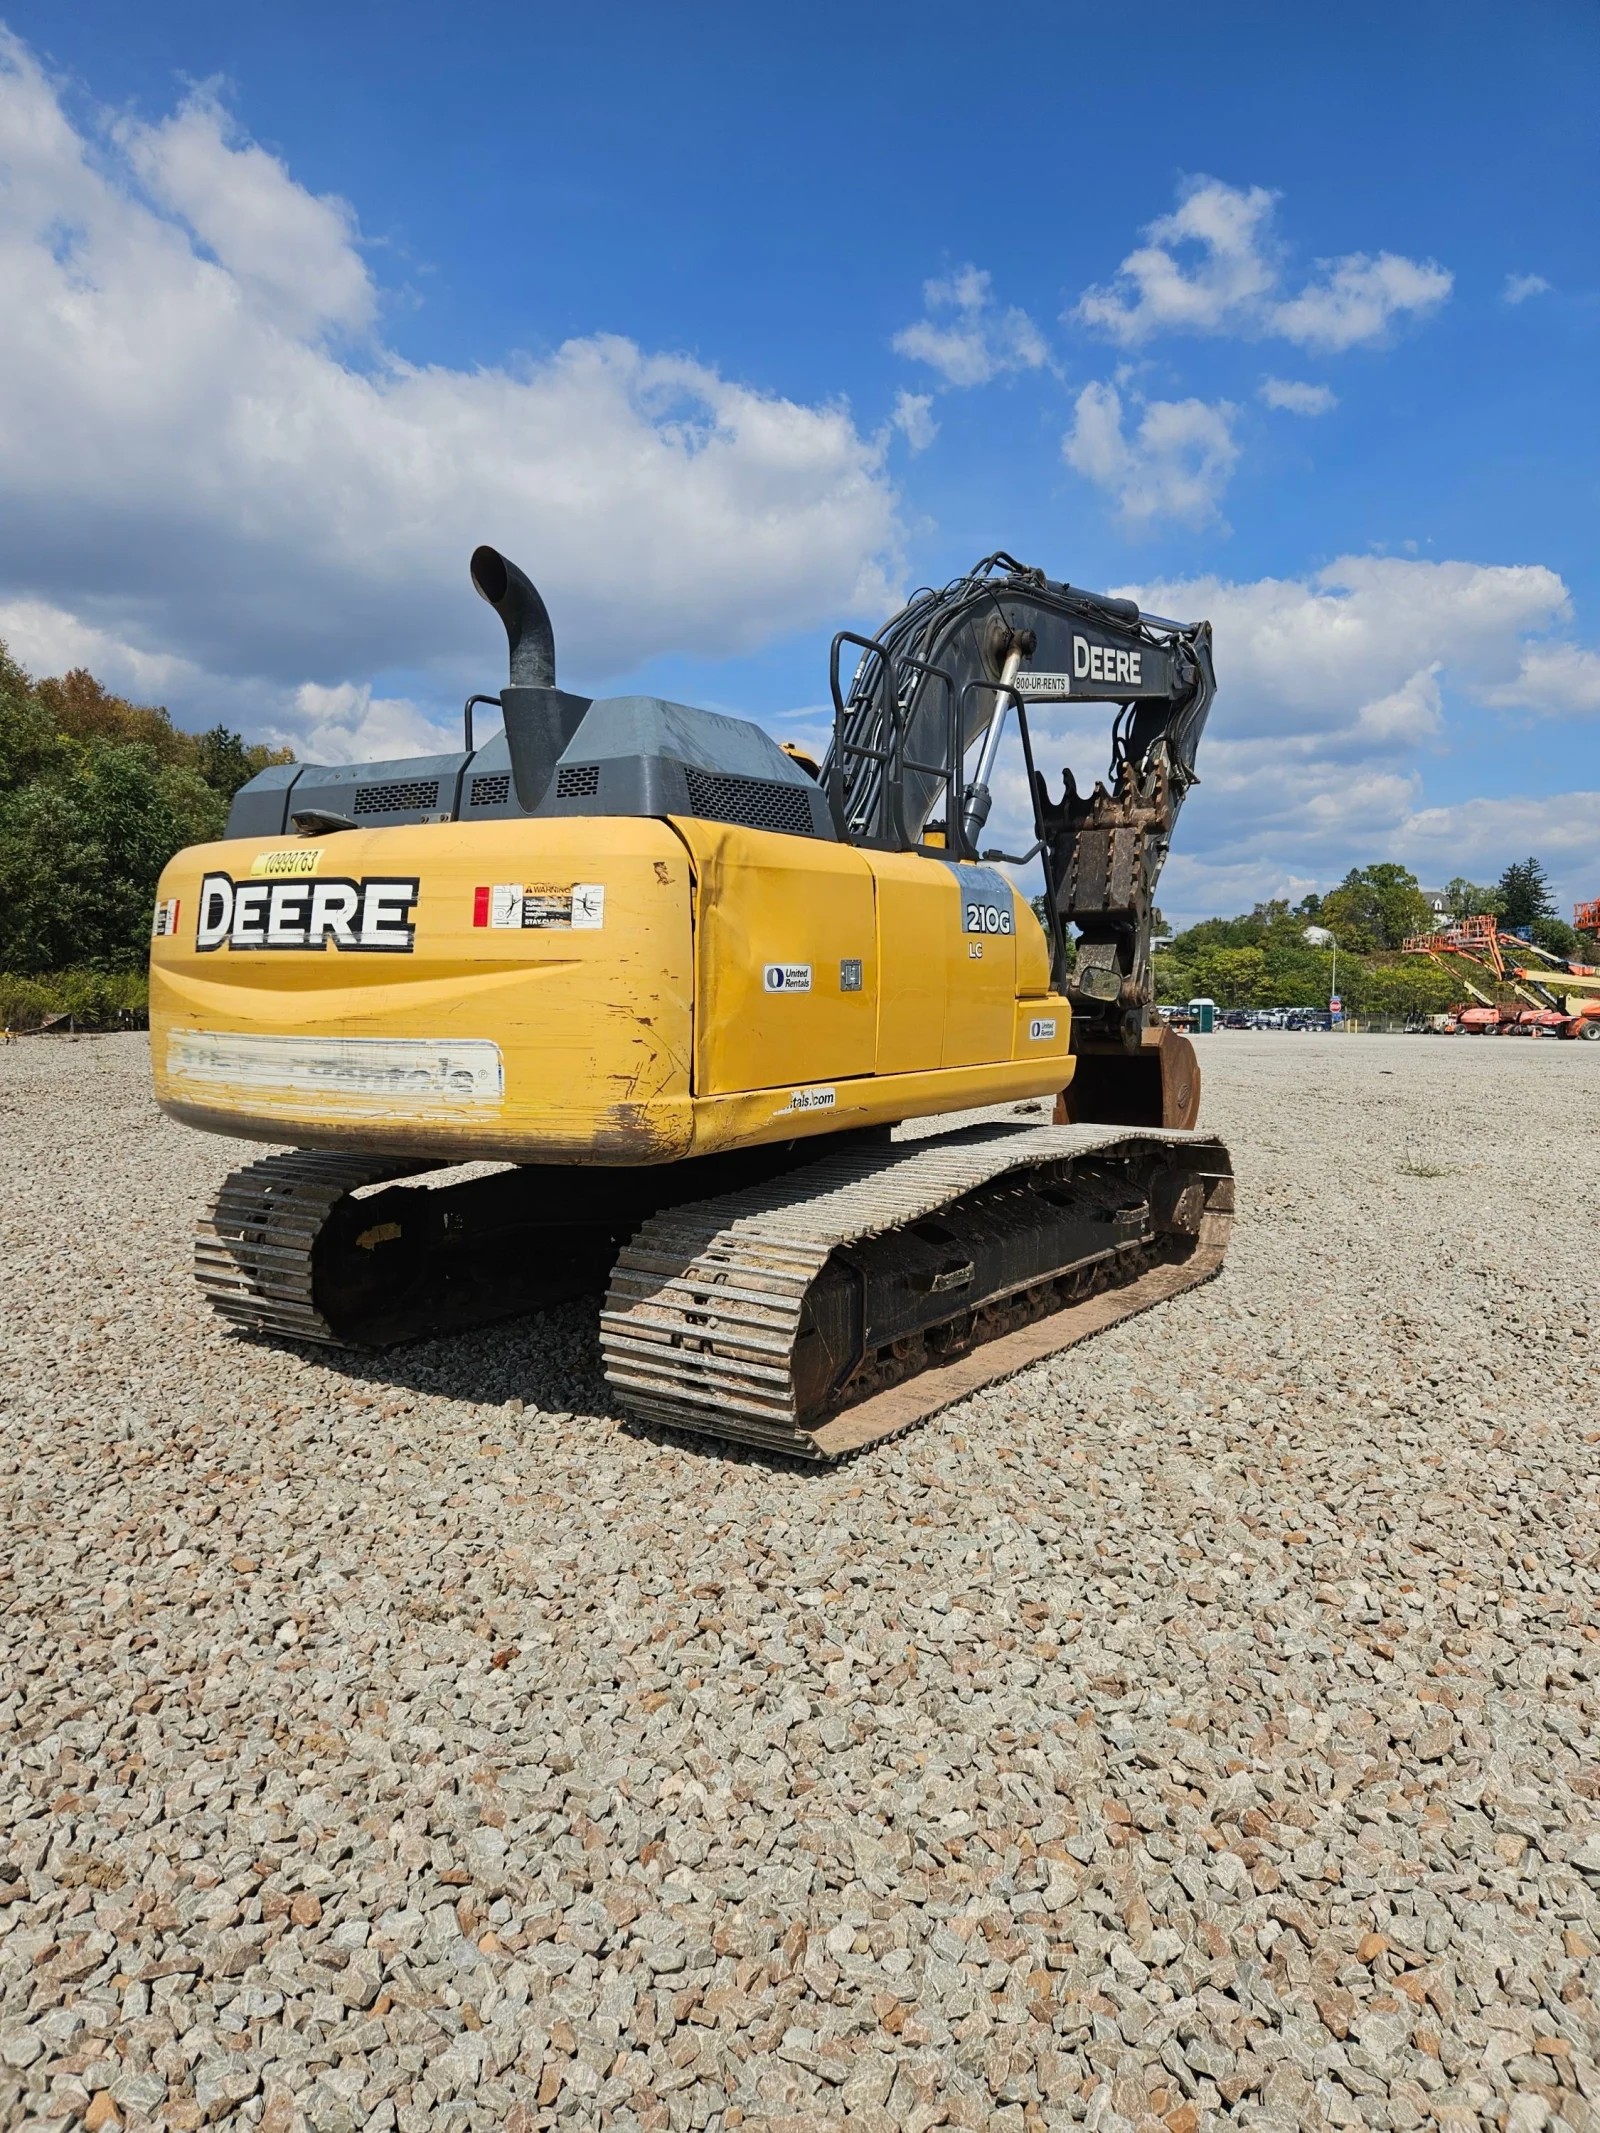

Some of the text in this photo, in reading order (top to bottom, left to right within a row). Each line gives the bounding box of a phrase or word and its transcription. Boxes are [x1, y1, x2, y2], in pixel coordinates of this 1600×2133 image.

[1073, 635, 1142, 685] DEERE
[1016, 677, 1066, 690] 800-UR-RENTS
[265, 851, 319, 873] 10999763
[533, 886, 571, 894] WARNING
[197, 873, 418, 951] DEERE
[967, 904, 1011, 935] 210G
[969, 942, 983, 959] LC
[785, 968, 808, 978] United
[785, 979, 810, 988] Rentals
